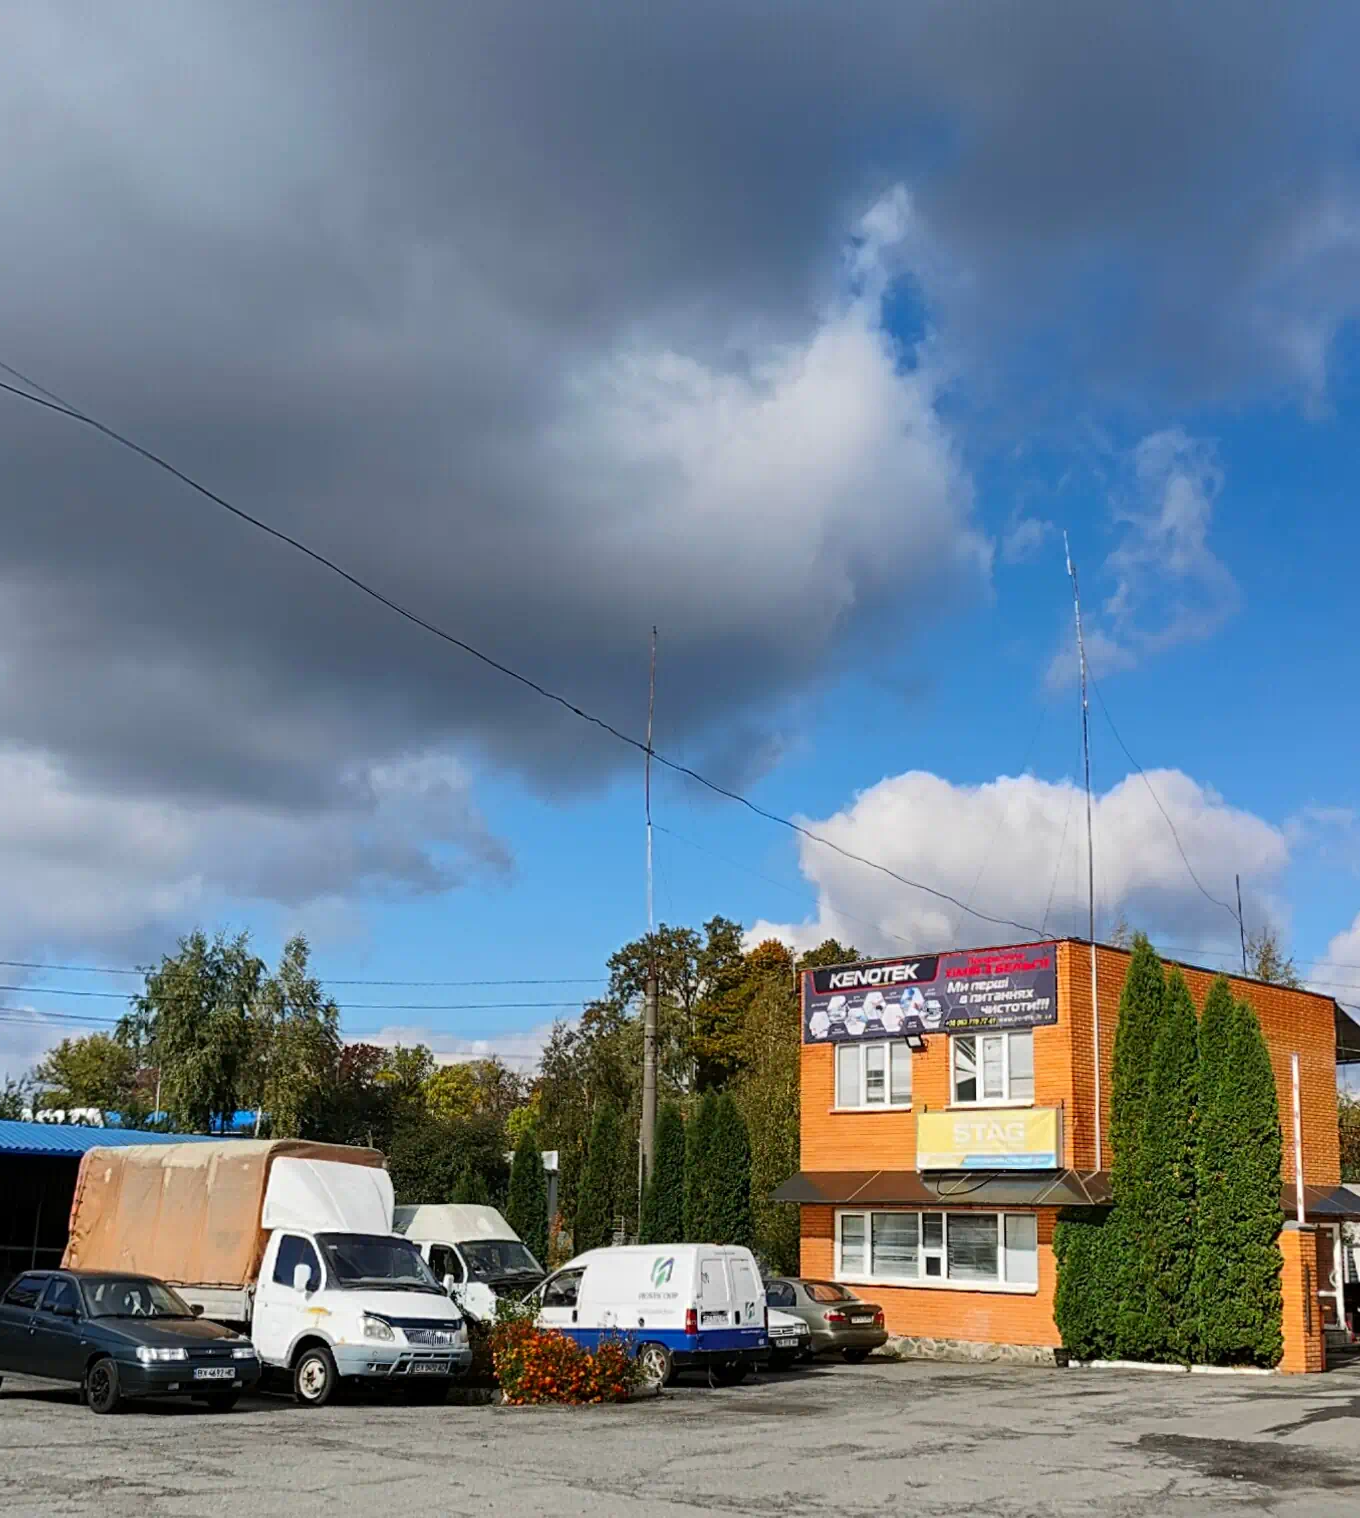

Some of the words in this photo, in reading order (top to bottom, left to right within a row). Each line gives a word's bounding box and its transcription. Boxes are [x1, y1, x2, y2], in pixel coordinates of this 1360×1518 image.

[829, 963, 920, 989] KENOTEK
[947, 981, 970, 994] Ми
[970, 977, 1010, 992] перші
[970, 988, 1035, 1004] питаннях
[980, 997, 1050, 1015] чистоти!!!
[954, 1122, 1024, 1143] STAG
